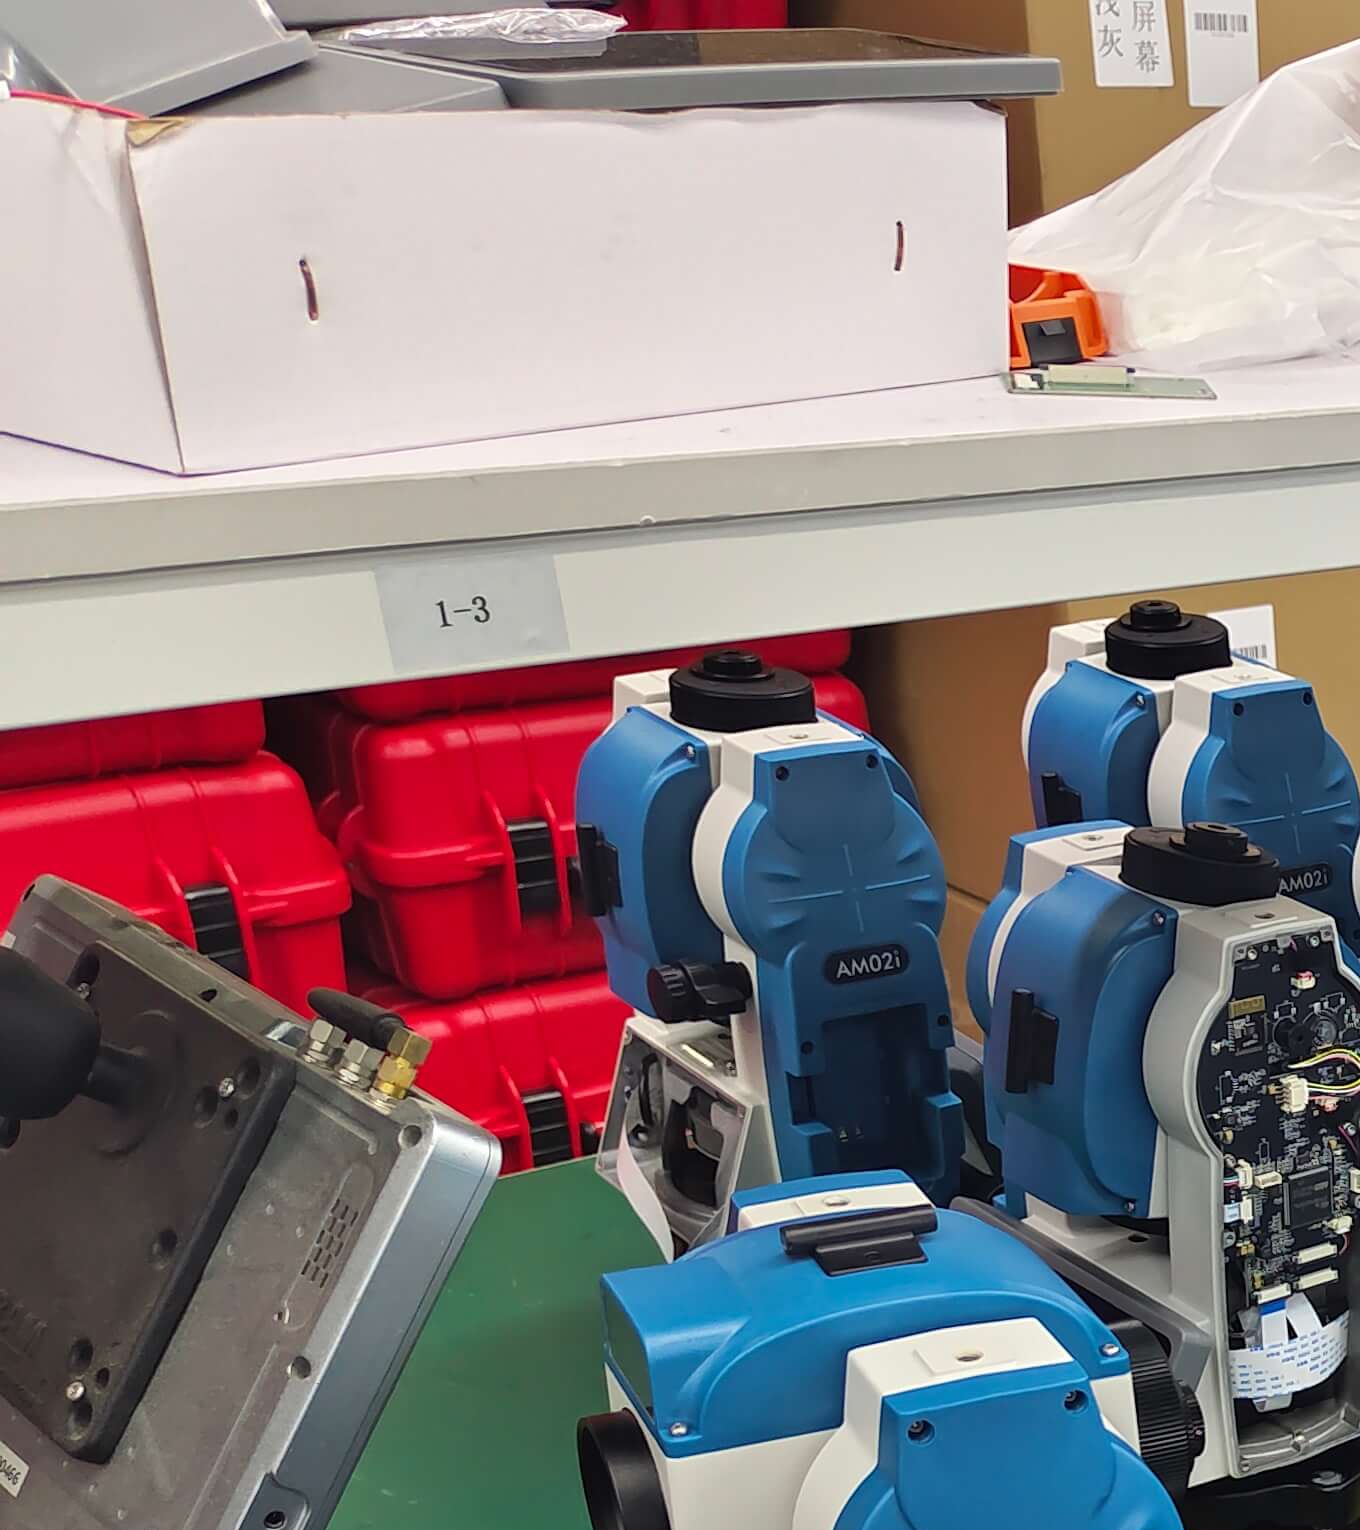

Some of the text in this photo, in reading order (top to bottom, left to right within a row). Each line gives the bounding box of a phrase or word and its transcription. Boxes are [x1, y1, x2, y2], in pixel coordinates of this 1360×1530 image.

[1132, 0, 1160, 73] 屏幕
[435, 595, 491, 629] 1-3
[1278, 867, 1329, 895] AM02i
[836, 949, 901, 979] AM02i
